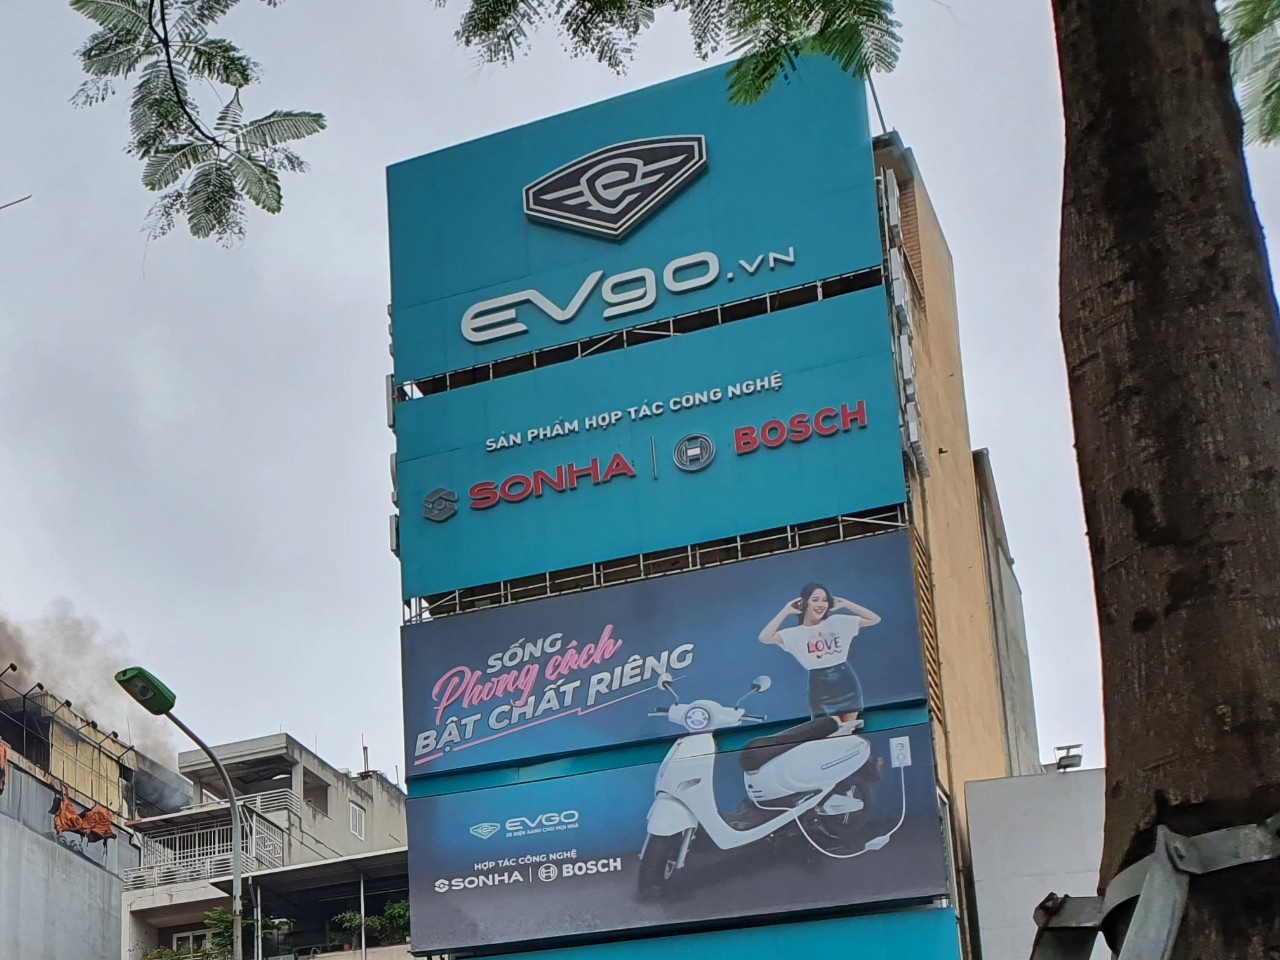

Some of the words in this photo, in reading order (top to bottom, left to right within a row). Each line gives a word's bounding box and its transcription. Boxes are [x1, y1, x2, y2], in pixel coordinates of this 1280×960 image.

[485, 429, 522, 452] SẢN
[584, 409, 623, 431] HỢP
[627, 399, 664, 419] TÁC
[669, 386, 723, 412] CÔNG
[727, 370, 784, 400] NGHỆ
[468, 452, 636, 510] SONHA
[733, 400, 869, 455] BOSCH
[486, 632, 563, 674] SỐNG
[807, 636, 842, 654] LOVE
[432, 661, 539, 726] Phong
[544, 623, 623, 681] cách
[414, 715, 482, 757] BẬT
[488, 679, 581, 731] CHẤT
[586, 643, 694, 706] RIÊNG
[505, 810, 579, 831] EVGO
[451, 870, 524, 890] SONHA
[562, 857, 622, 877] BOSCH
[474, 860, 496, 872] HỢP
[497, 857, 517, 869] TÁC
[518, 852, 548, 866] CÔNG
[549, 848, 578, 861] NGHỆ
